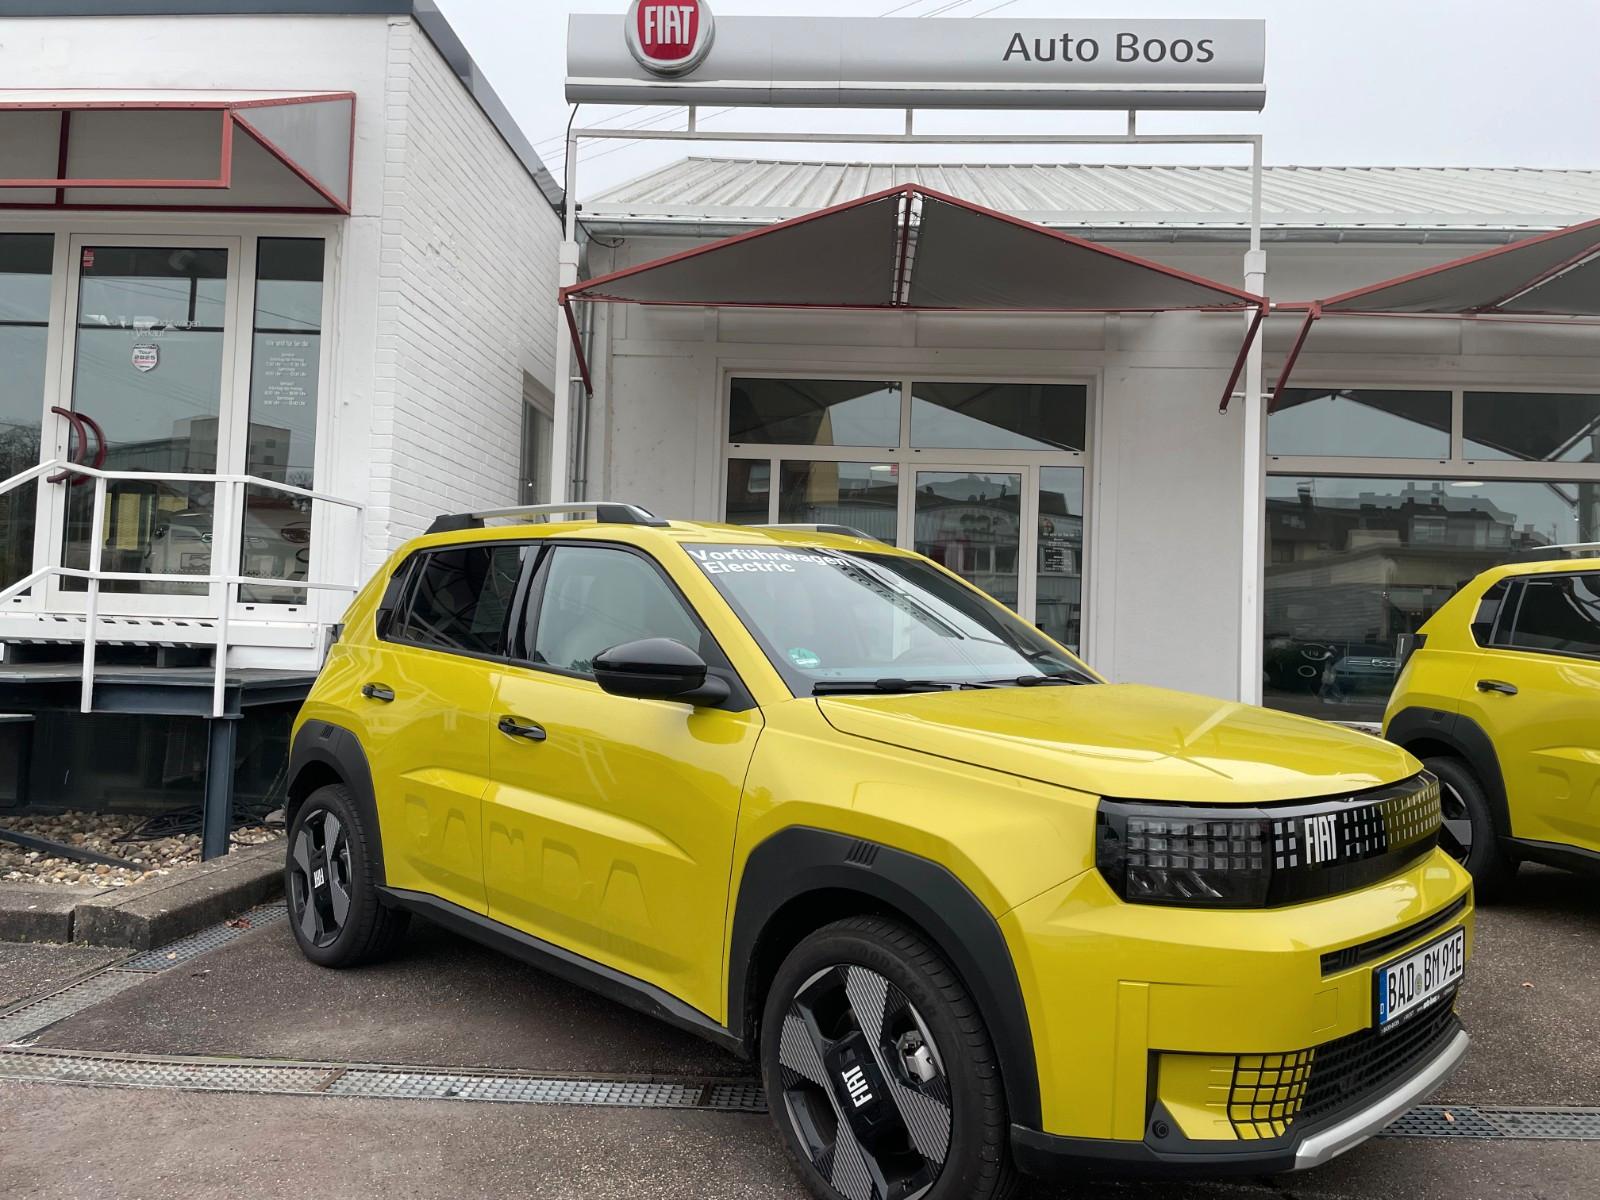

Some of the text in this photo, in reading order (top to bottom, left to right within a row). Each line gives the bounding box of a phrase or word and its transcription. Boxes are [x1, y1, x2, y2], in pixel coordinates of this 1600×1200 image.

[644, 6, 694, 44] FIAT
[1002, 32, 1214, 62] Auto Boos
[687, 549, 850, 567] Vorführwagen
[702, 560, 796, 574] Electric
[1303, 813, 1338, 865] FIAT
[1388, 935, 1462, 1014] BAD BM 91E
[841, 1065, 873, 1108] FIAT
